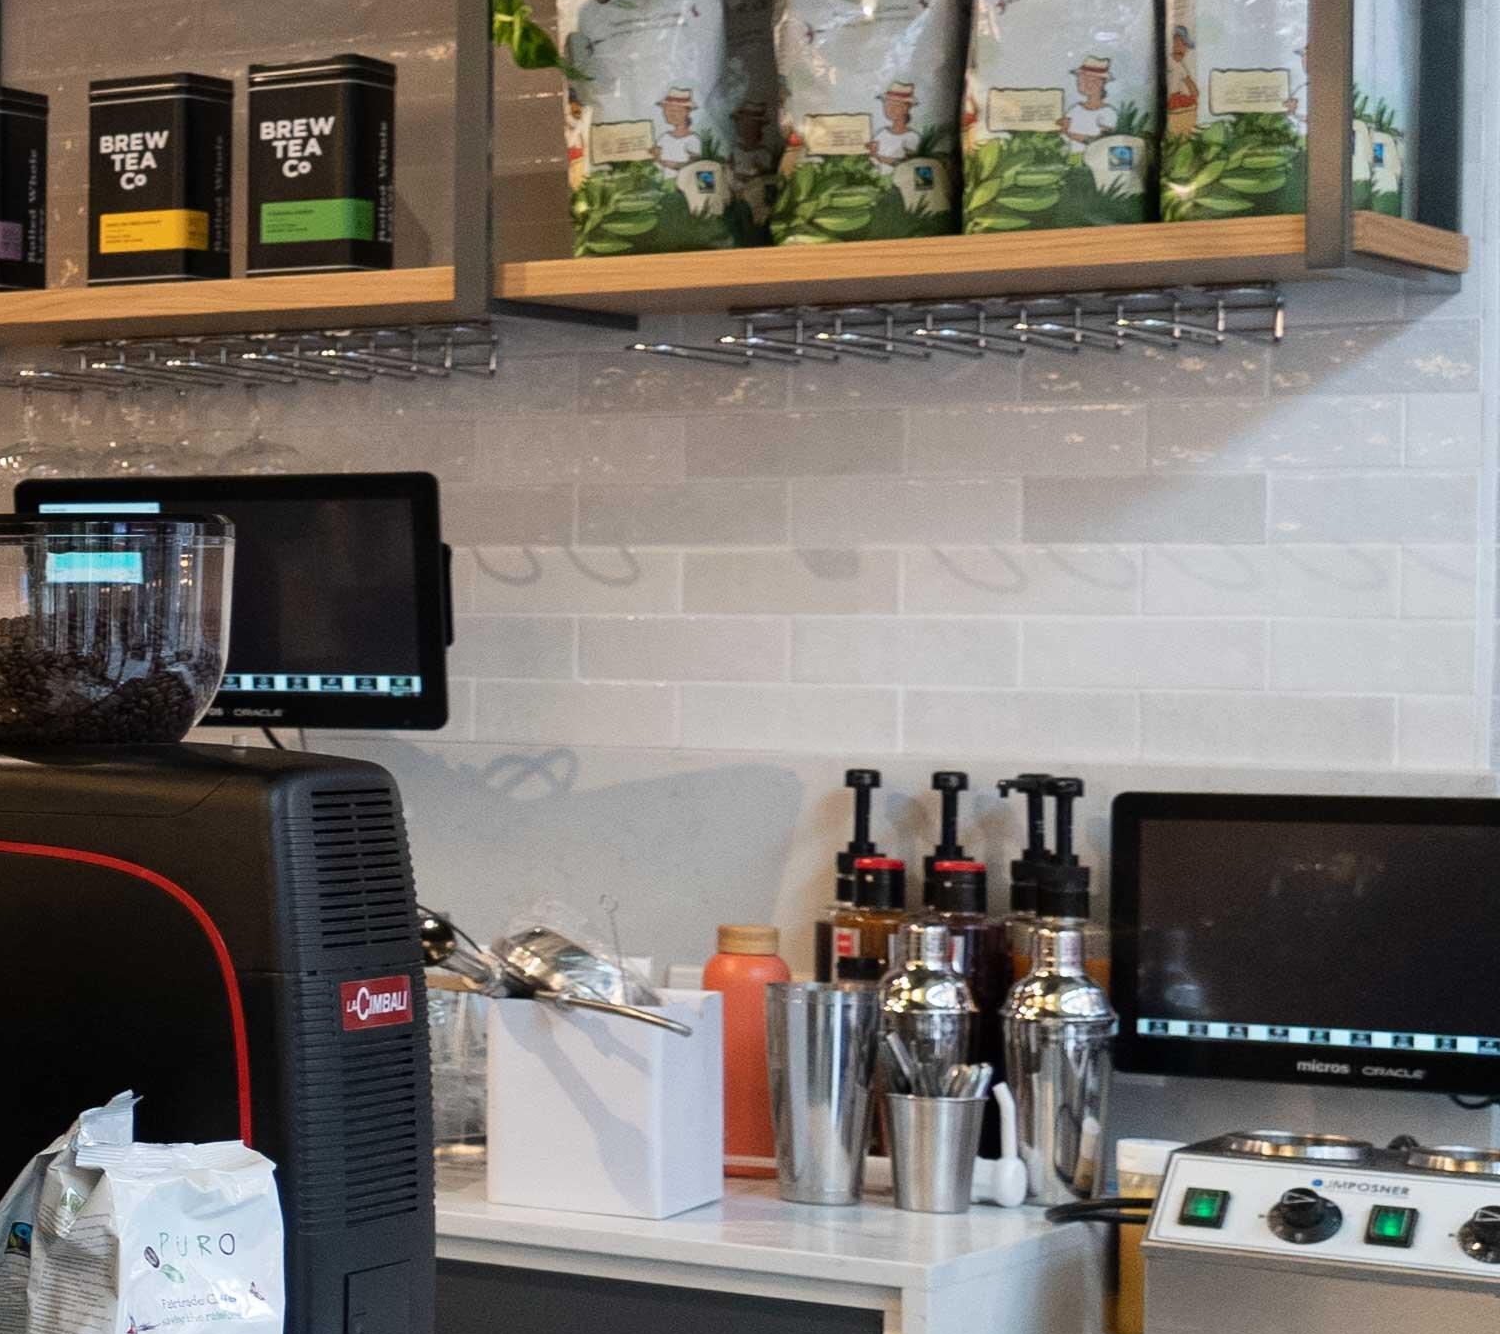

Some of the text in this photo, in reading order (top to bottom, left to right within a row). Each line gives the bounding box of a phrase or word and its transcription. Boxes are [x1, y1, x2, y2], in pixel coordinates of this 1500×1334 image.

[260, 116, 335, 140] BREW
[100, 130, 169, 154] BREW
[271, 137, 323, 159] TEA
[110, 151, 157, 172] TEA
[1297, 1058, 1427, 1080] micros ORACLE
[159, 1231, 236, 1257] PURO
